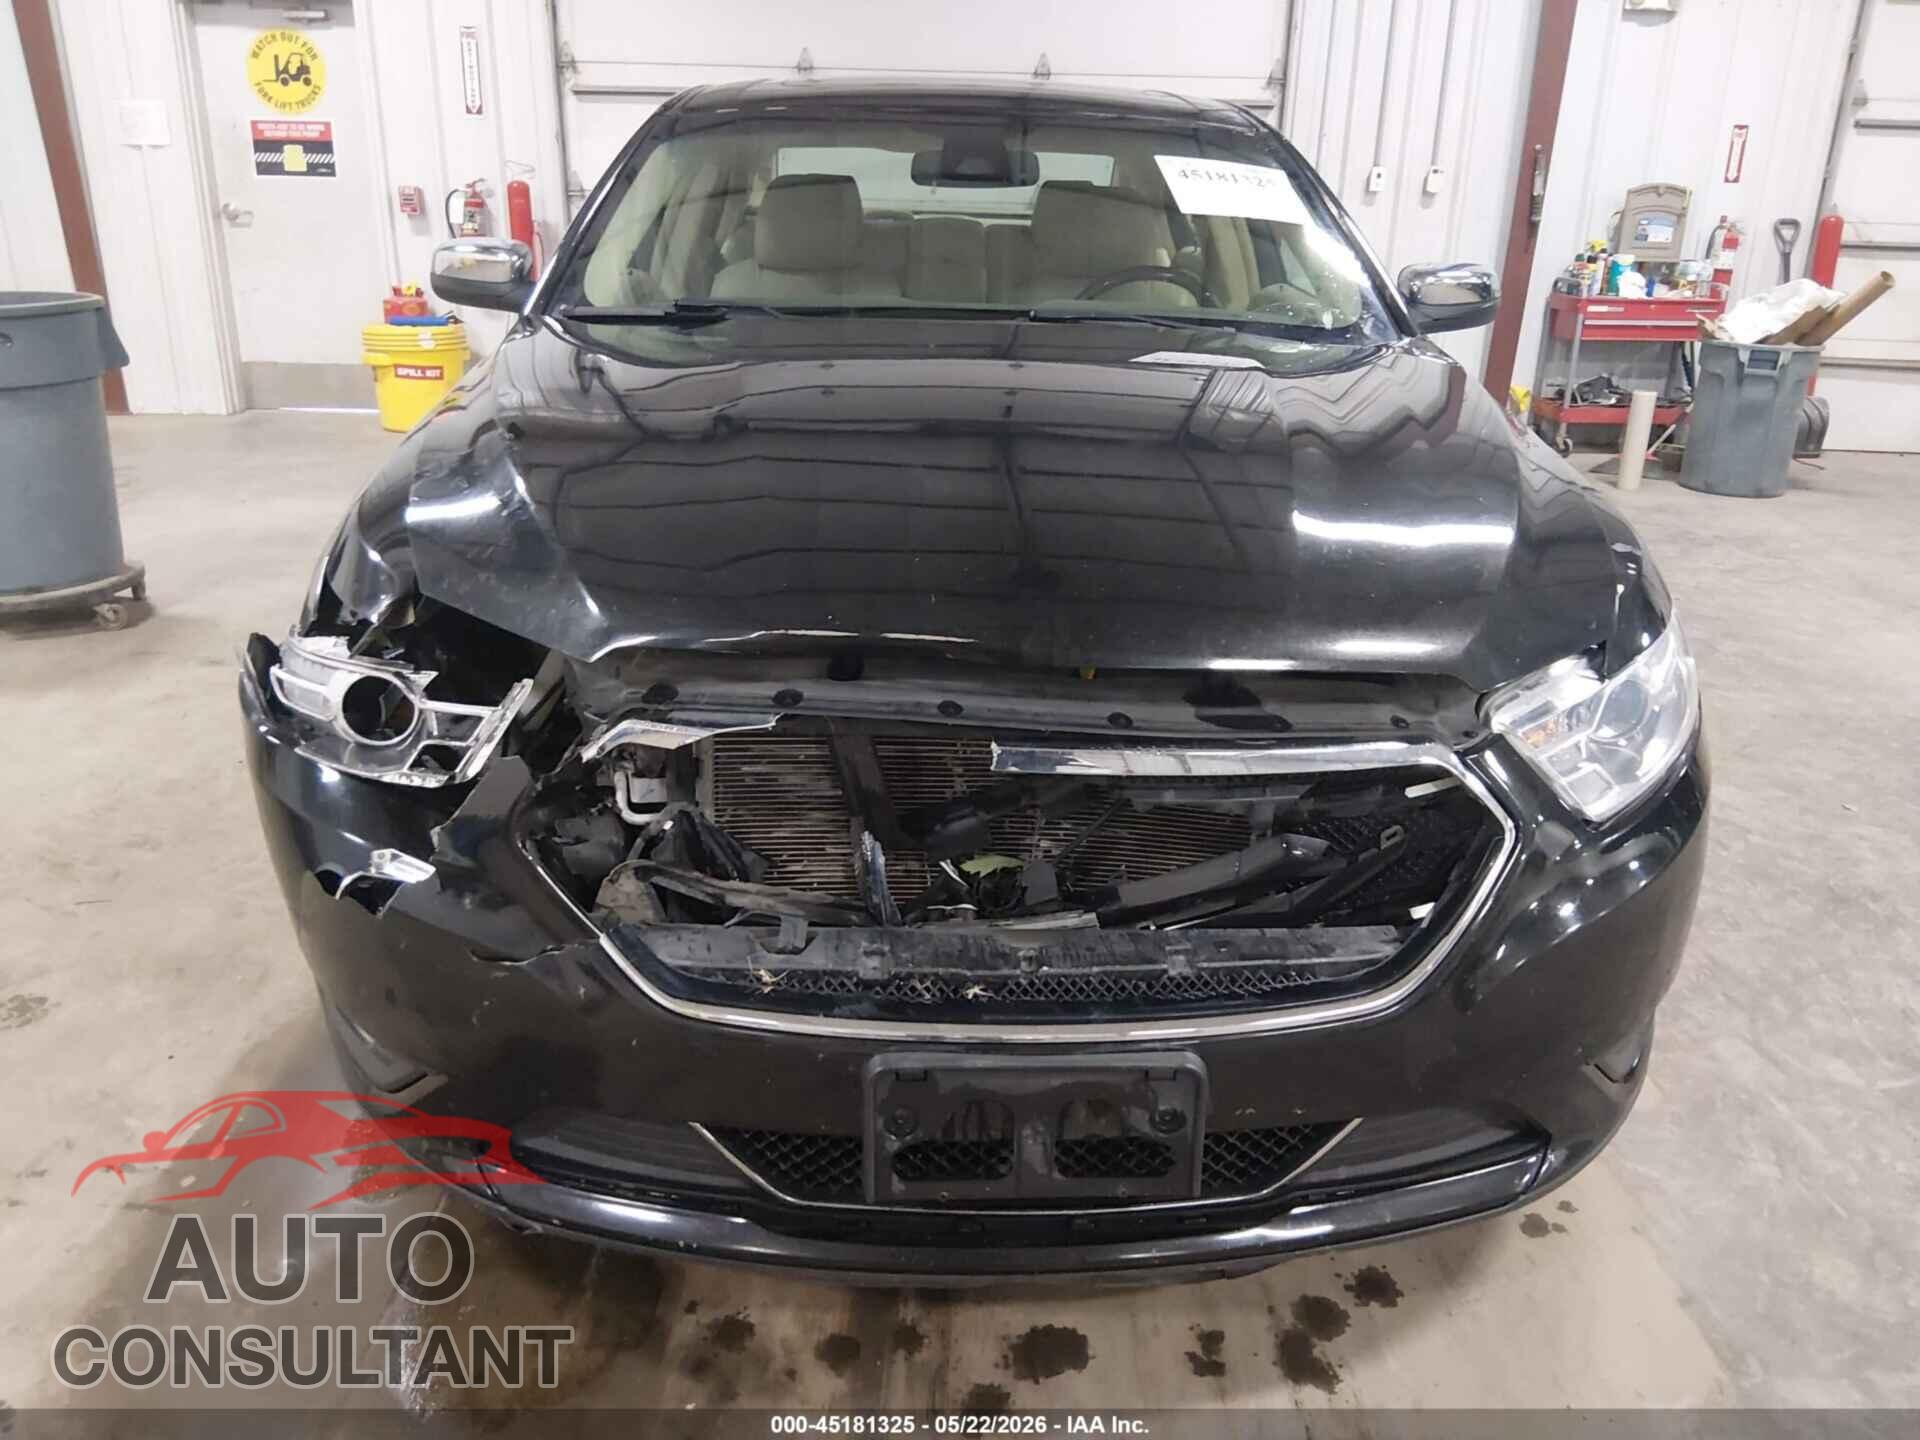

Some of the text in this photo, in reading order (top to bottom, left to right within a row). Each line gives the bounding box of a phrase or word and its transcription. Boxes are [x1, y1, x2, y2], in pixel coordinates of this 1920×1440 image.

[252, 32, 318, 61] WATCH OUT FOR
[274, 101, 293, 111] LIFT
[295, 84, 321, 109] TRUCKS
[397, 367, 440, 377] SPILL KIT
